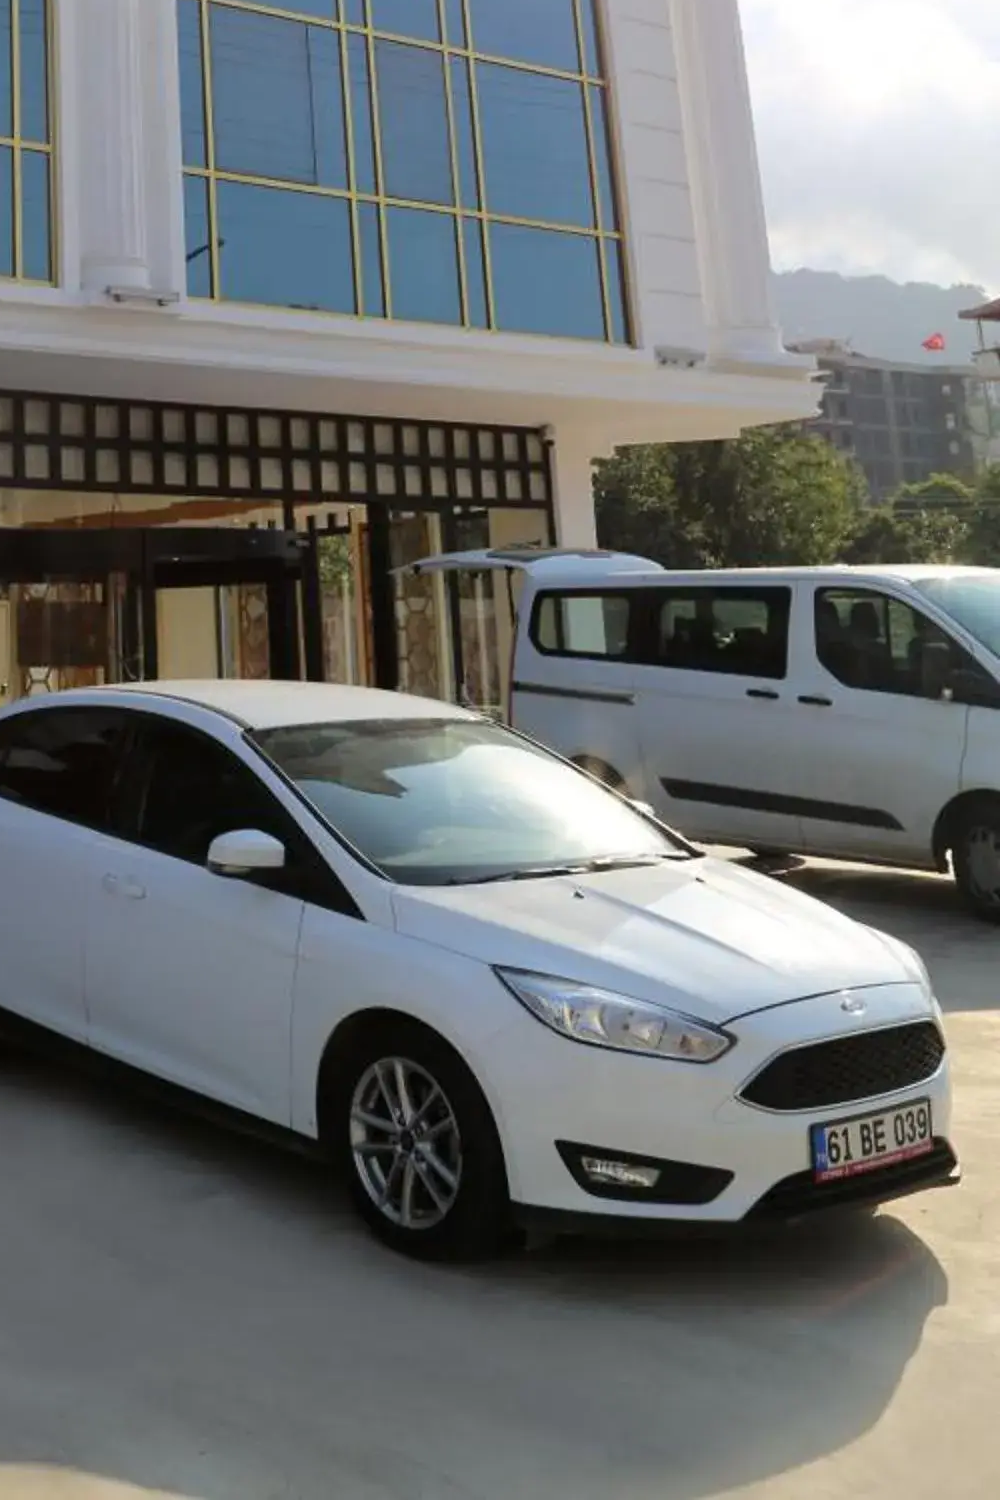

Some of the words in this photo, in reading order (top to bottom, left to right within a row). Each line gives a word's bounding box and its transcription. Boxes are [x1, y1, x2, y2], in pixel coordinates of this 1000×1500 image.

[827, 1127, 852, 1163] 61
[860, 1119, 886, 1156] BE
[894, 1108, 927, 1146] 039
